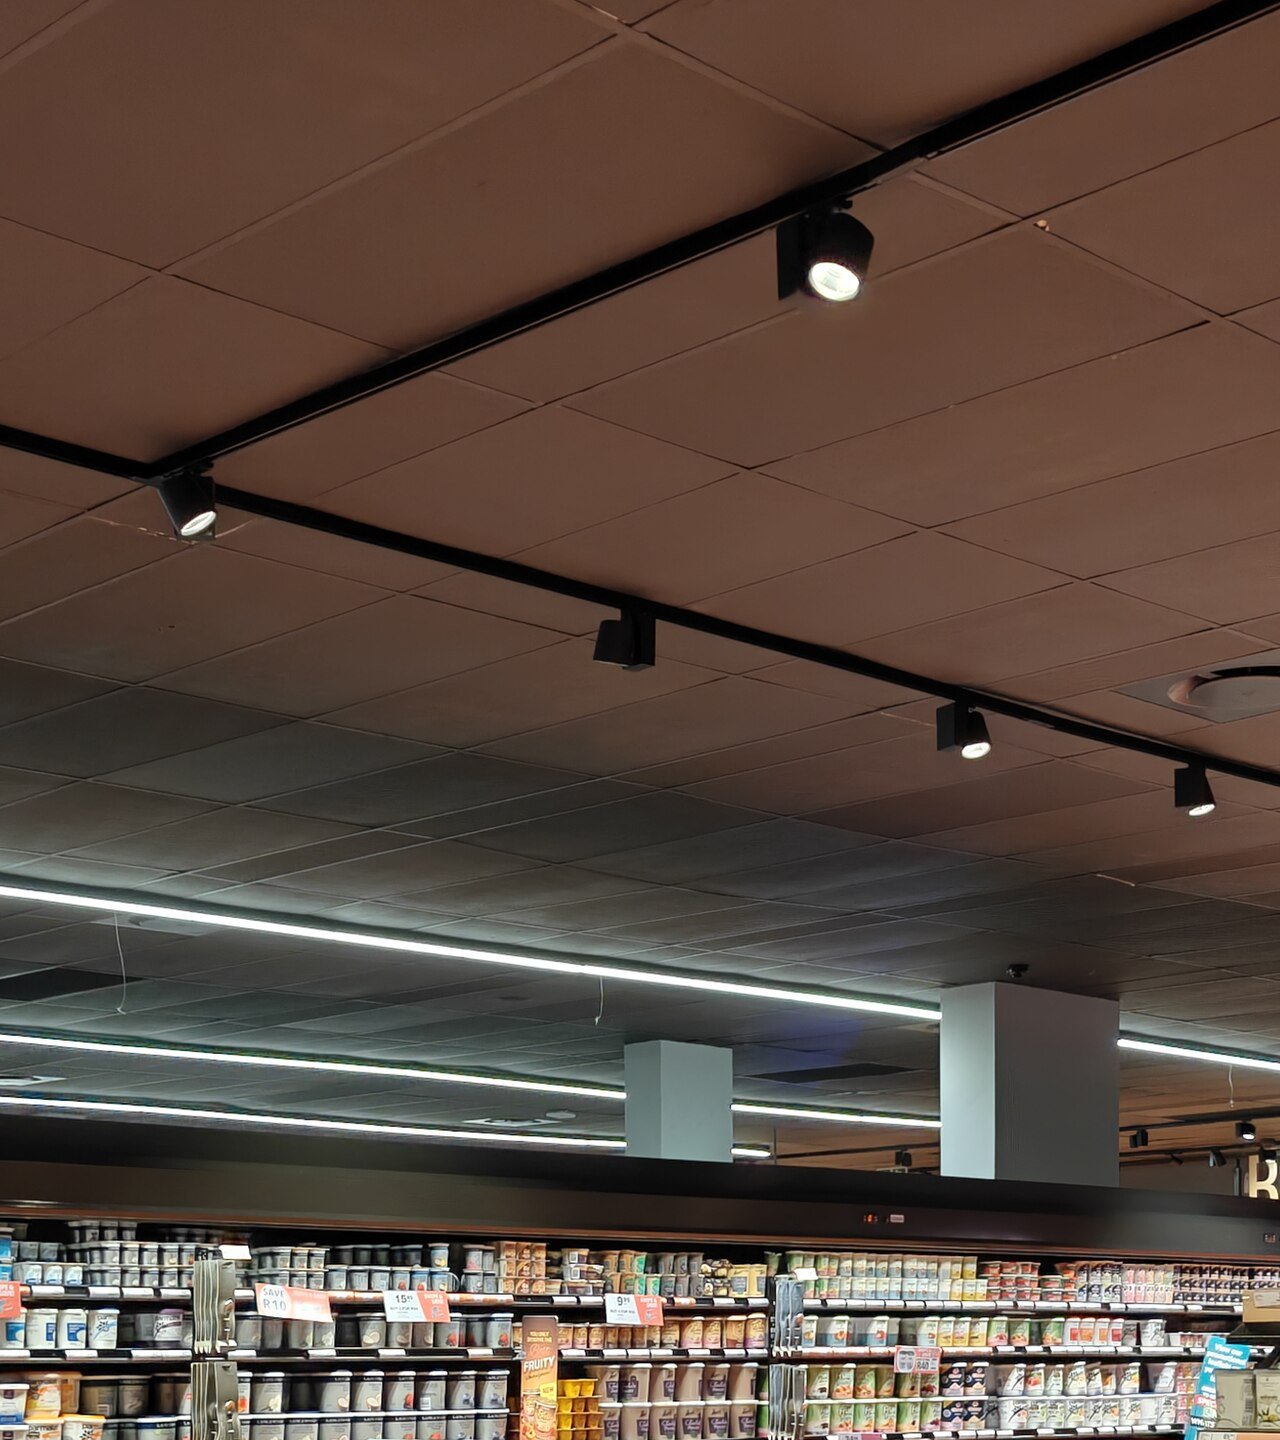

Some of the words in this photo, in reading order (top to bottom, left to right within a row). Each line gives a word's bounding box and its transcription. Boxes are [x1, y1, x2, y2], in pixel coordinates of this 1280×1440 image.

[263, 1287, 285, 1298] SAVE
[263, 1298, 286, 1311] R10
[524, 1356, 555, 1373] FRUITY
